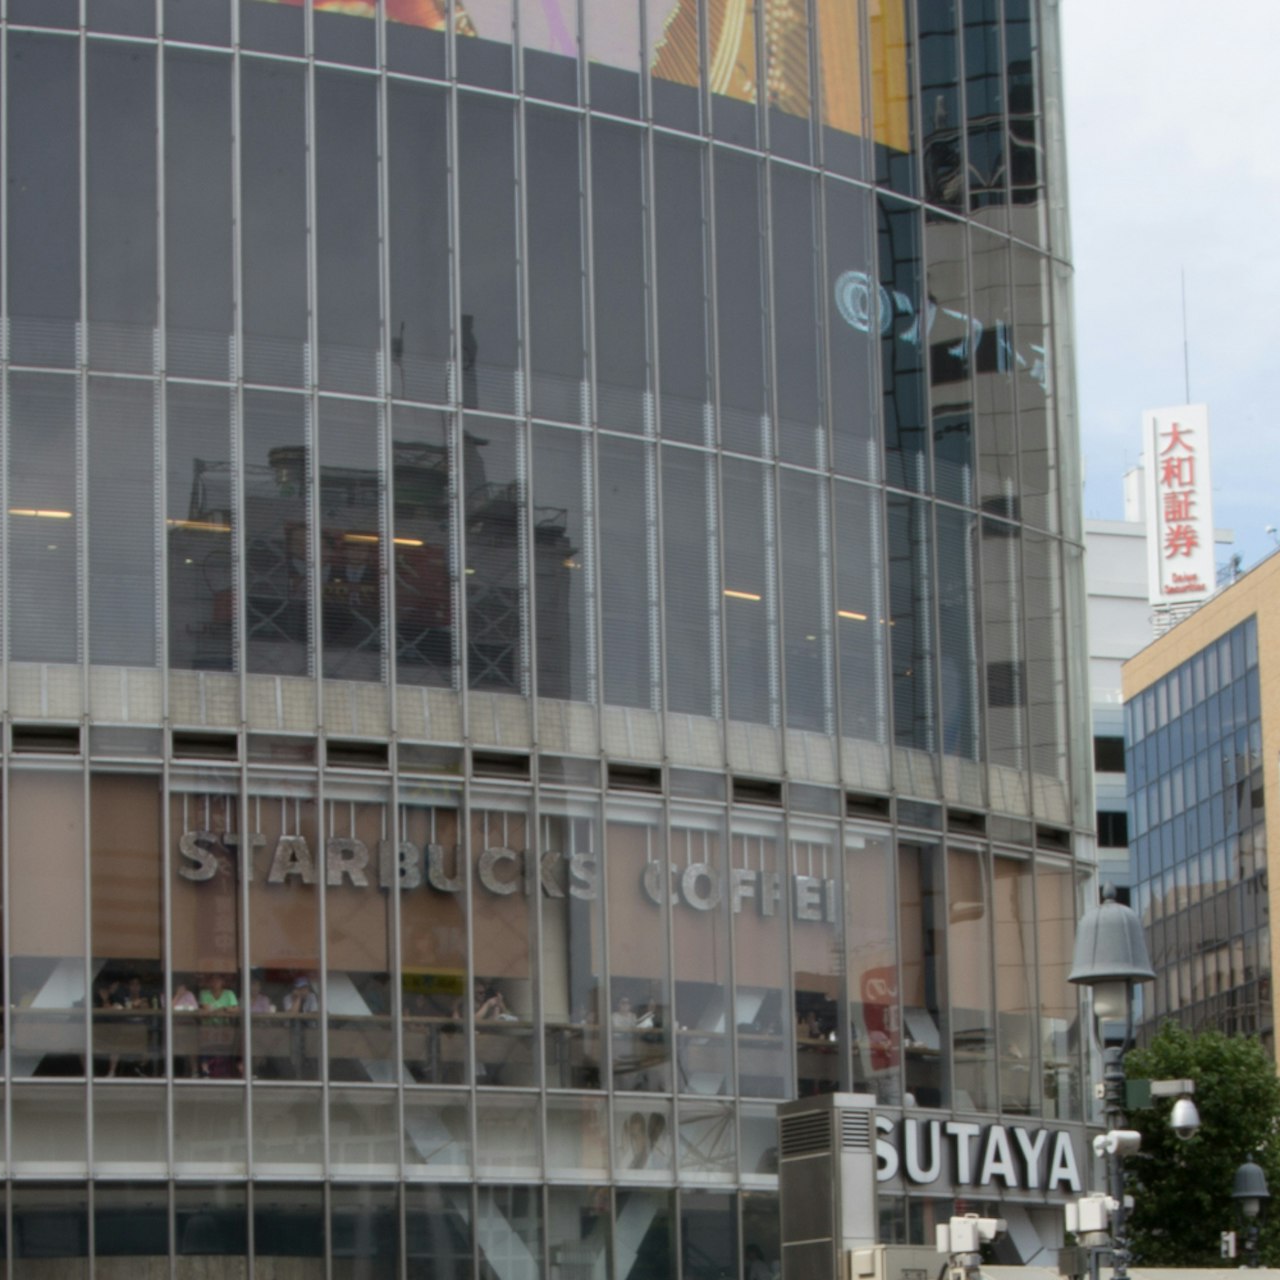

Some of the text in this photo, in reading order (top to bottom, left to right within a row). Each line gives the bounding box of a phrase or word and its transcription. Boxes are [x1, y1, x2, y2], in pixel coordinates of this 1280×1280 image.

[1160, 422, 1199, 560] 大和証券
[178, 830, 598, 900] STARBUCKS
